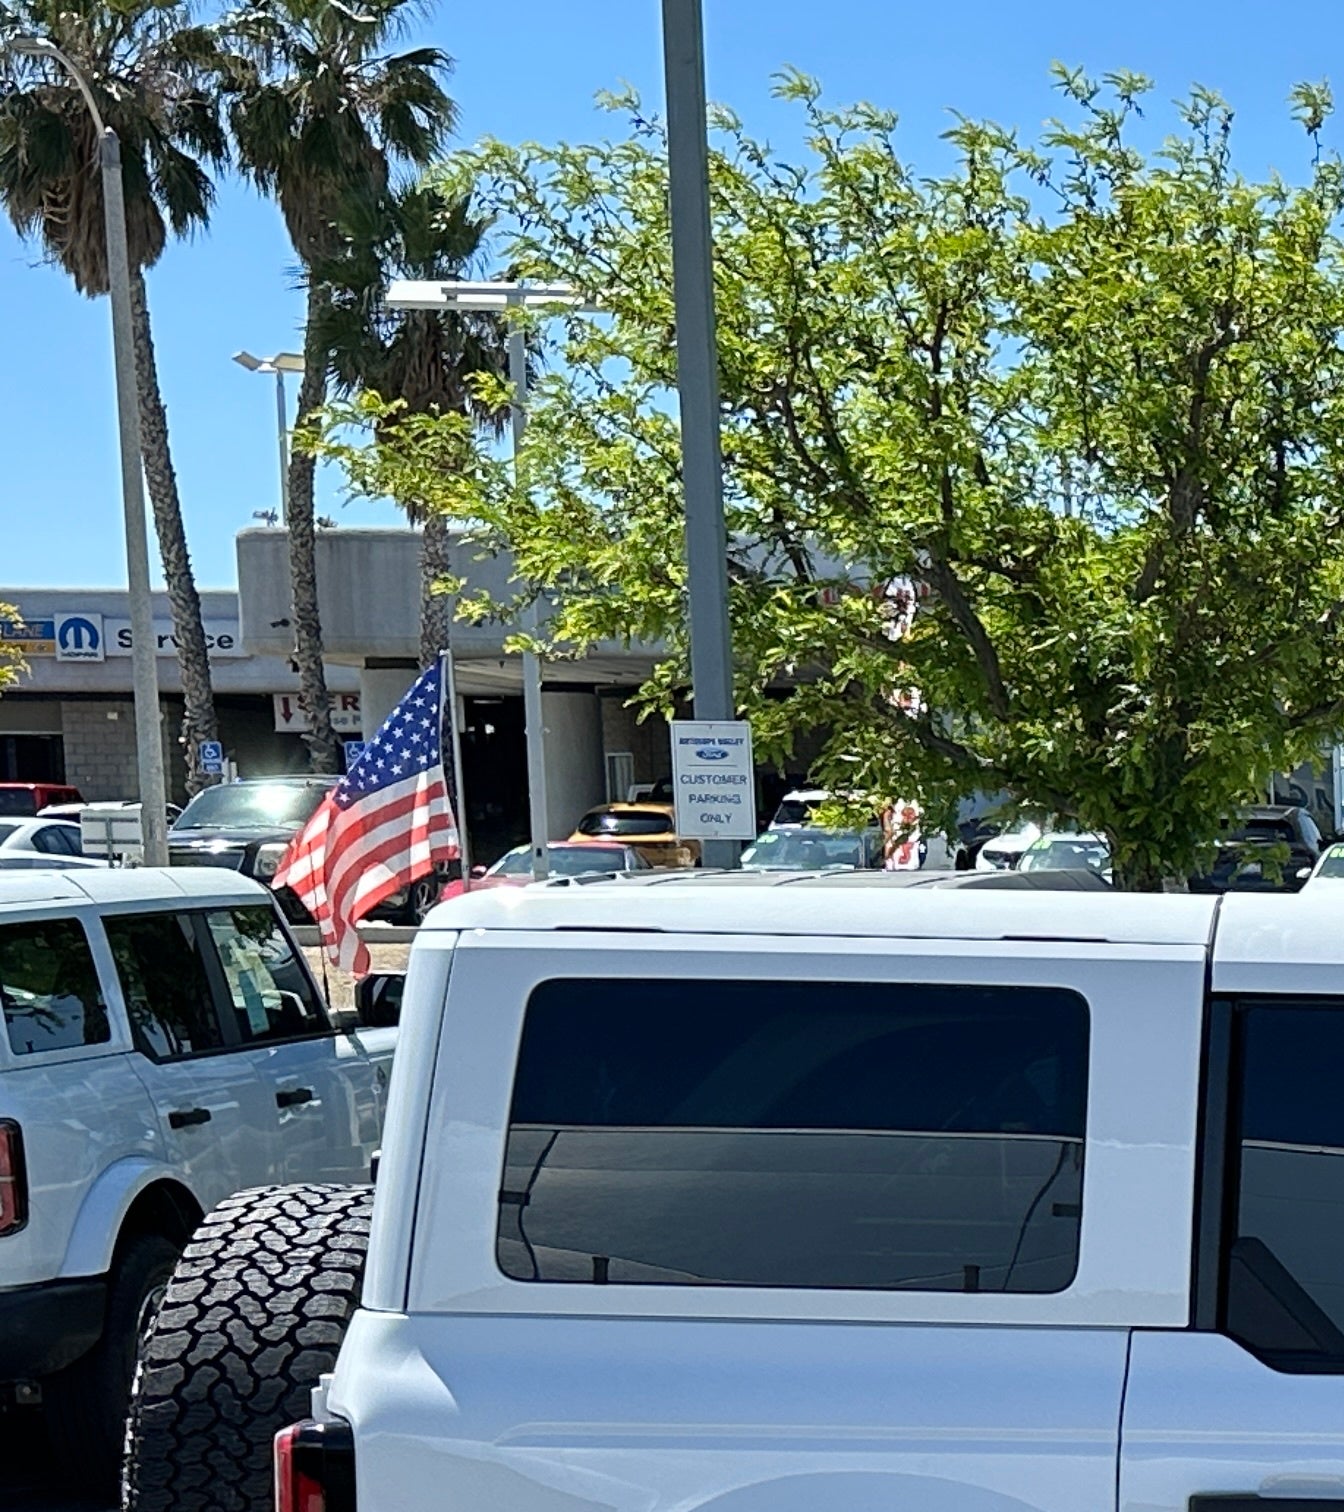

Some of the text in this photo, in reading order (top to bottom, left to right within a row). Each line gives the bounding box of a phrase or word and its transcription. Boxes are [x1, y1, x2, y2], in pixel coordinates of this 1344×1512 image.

[680, 774, 748, 785] CUSTOMER
[688, 793, 742, 804] PARKING
[699, 812, 732, 823] ONLY
